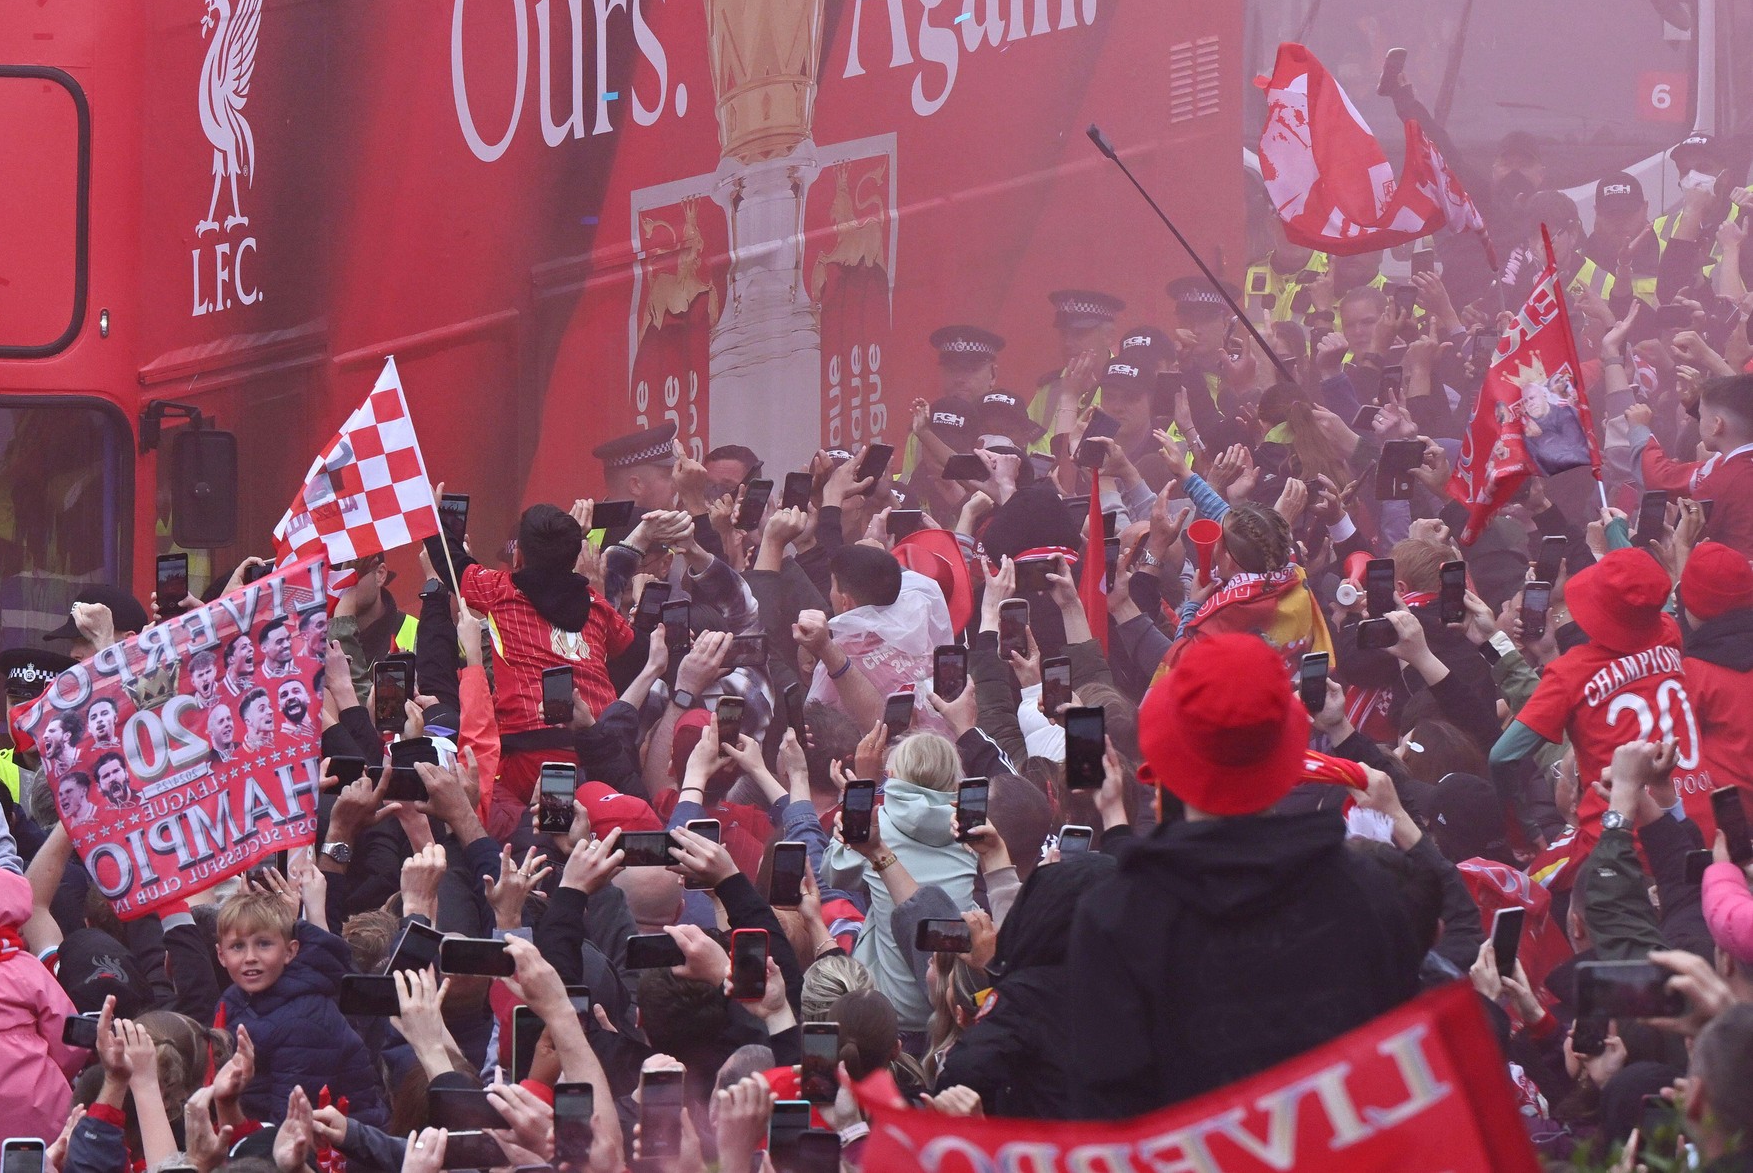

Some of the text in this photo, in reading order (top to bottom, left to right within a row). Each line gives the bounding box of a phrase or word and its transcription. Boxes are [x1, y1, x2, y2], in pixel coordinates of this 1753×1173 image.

[1651, 83, 1672, 110] 6
[191, 234, 264, 317] L.F.C.
[934, 412, 965, 425] FGH
[1584, 645, 1686, 707] CHAMPION
